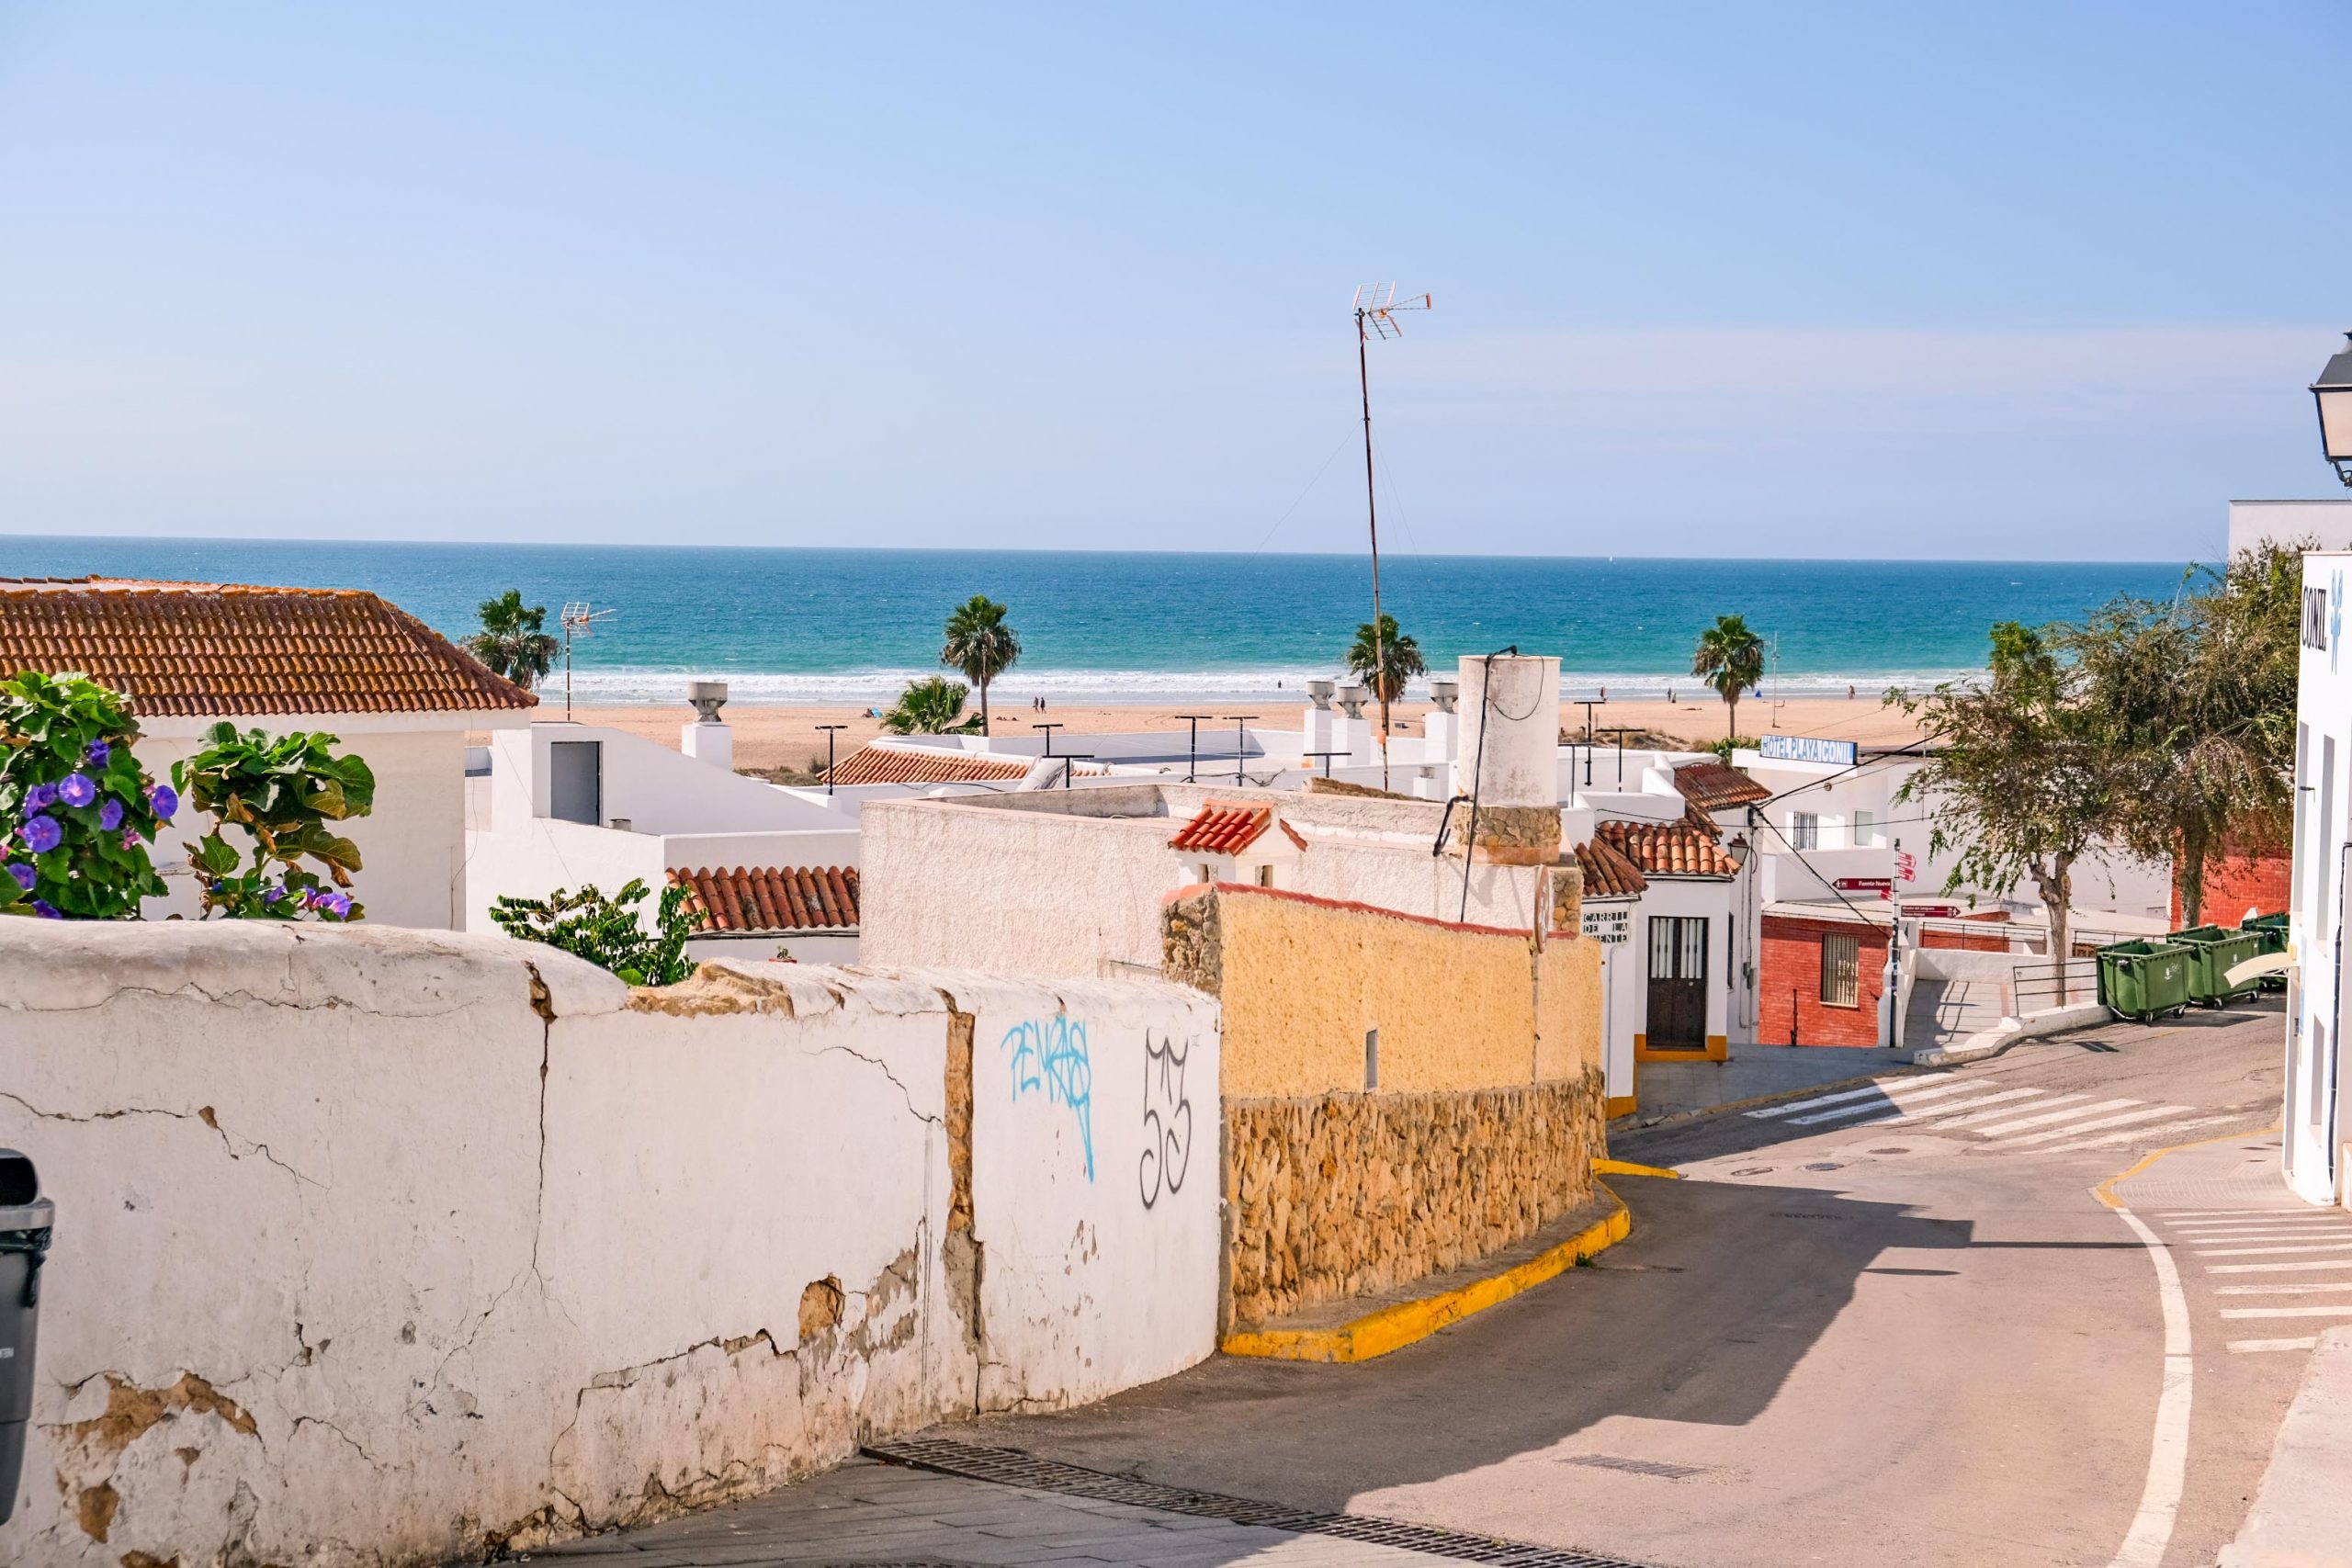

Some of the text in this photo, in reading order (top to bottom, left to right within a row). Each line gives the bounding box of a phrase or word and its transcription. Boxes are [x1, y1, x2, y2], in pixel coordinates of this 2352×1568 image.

[2301, 585, 2326, 651] CONIL
[1761, 736, 1853, 764] HOTEL PLAYA CONIL
[1583, 912, 1627, 922] CARRIL
[1583, 923, 1628, 933] DE LA
[1589, 934, 1628, 943] UENTE
